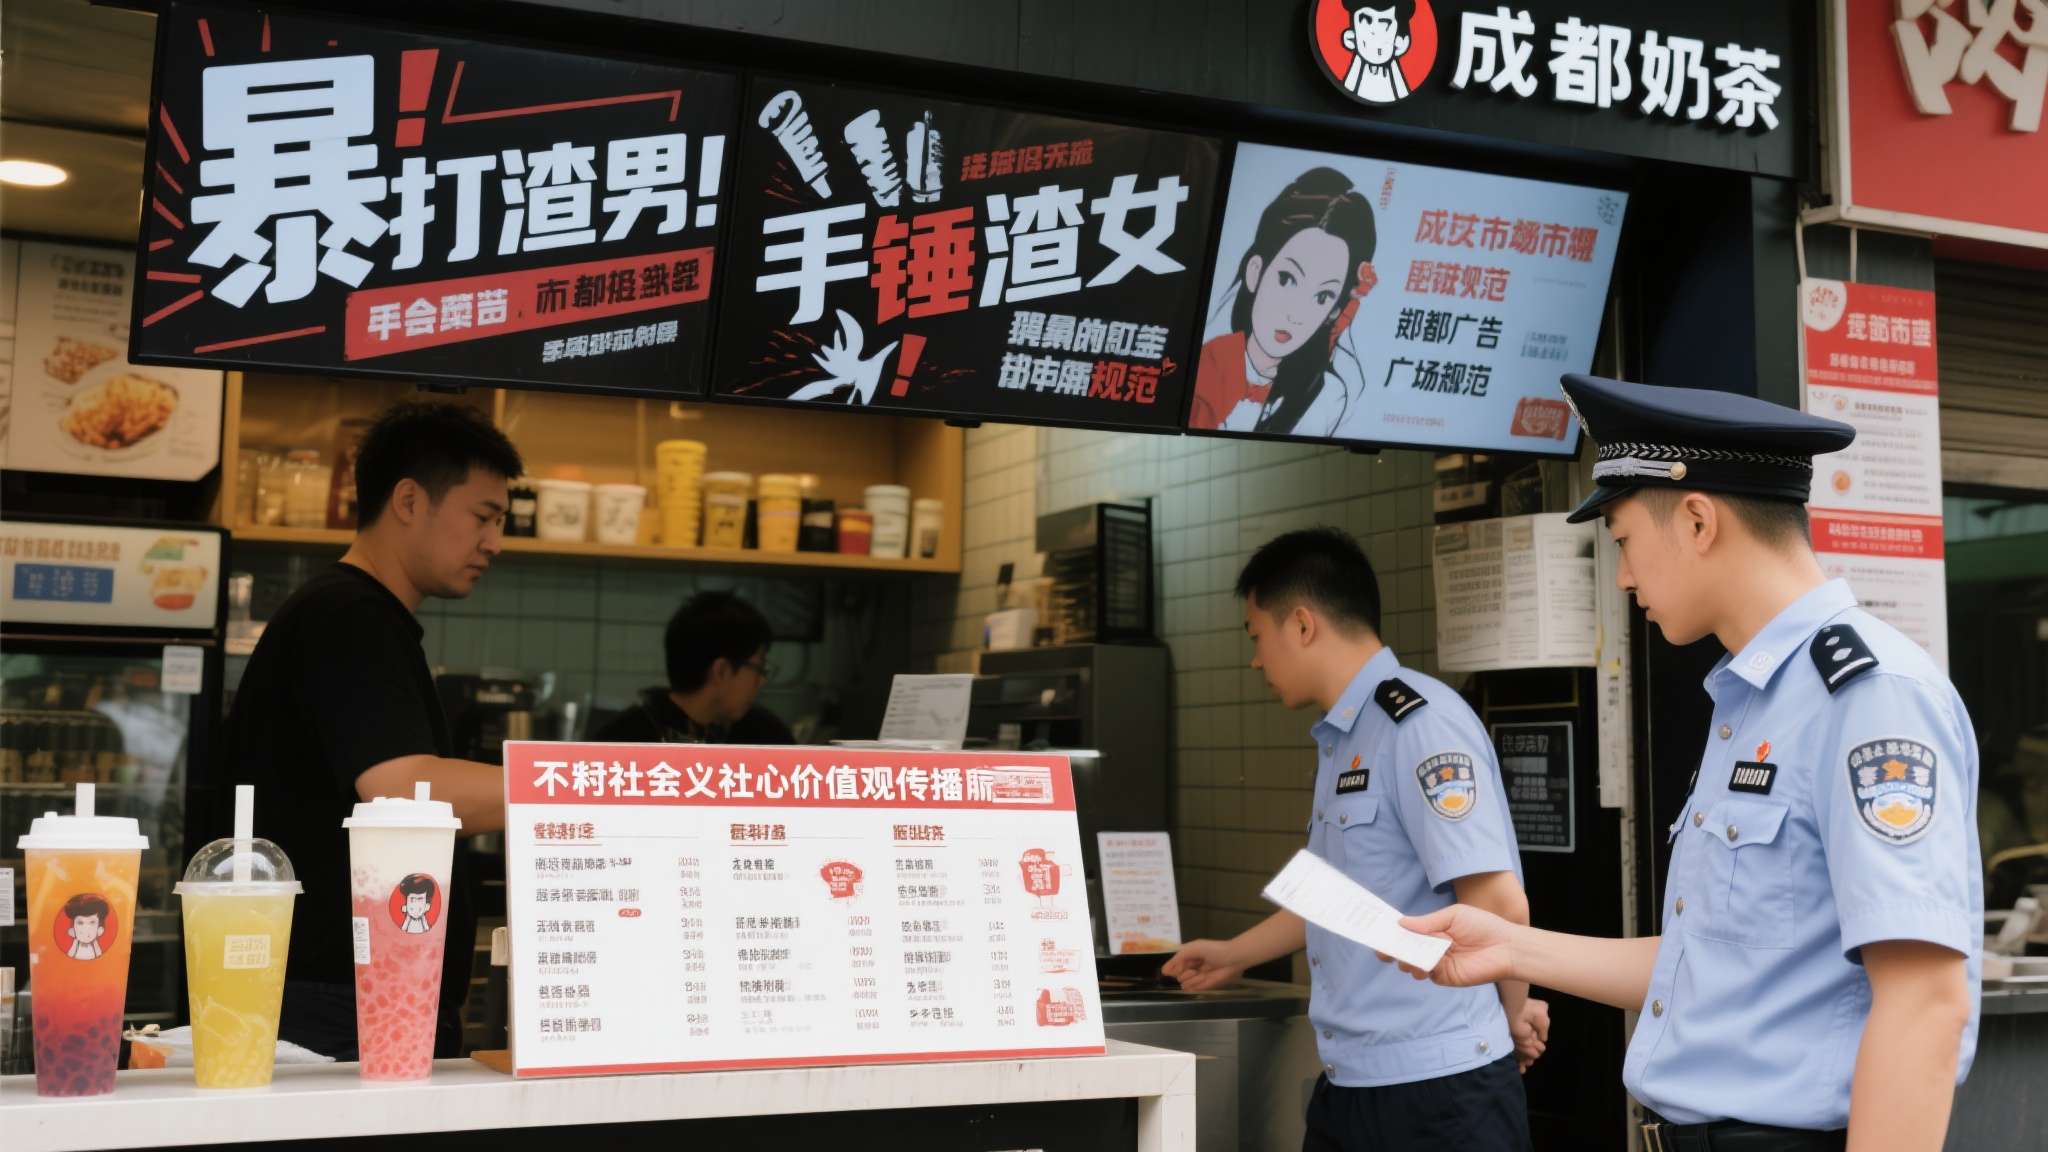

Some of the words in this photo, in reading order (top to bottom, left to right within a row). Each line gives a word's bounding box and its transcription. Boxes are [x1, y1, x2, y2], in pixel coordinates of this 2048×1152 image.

[1449, 6, 1783, 131] 成都奶茶
[755, 173, 1190, 325] 手锤渣女
